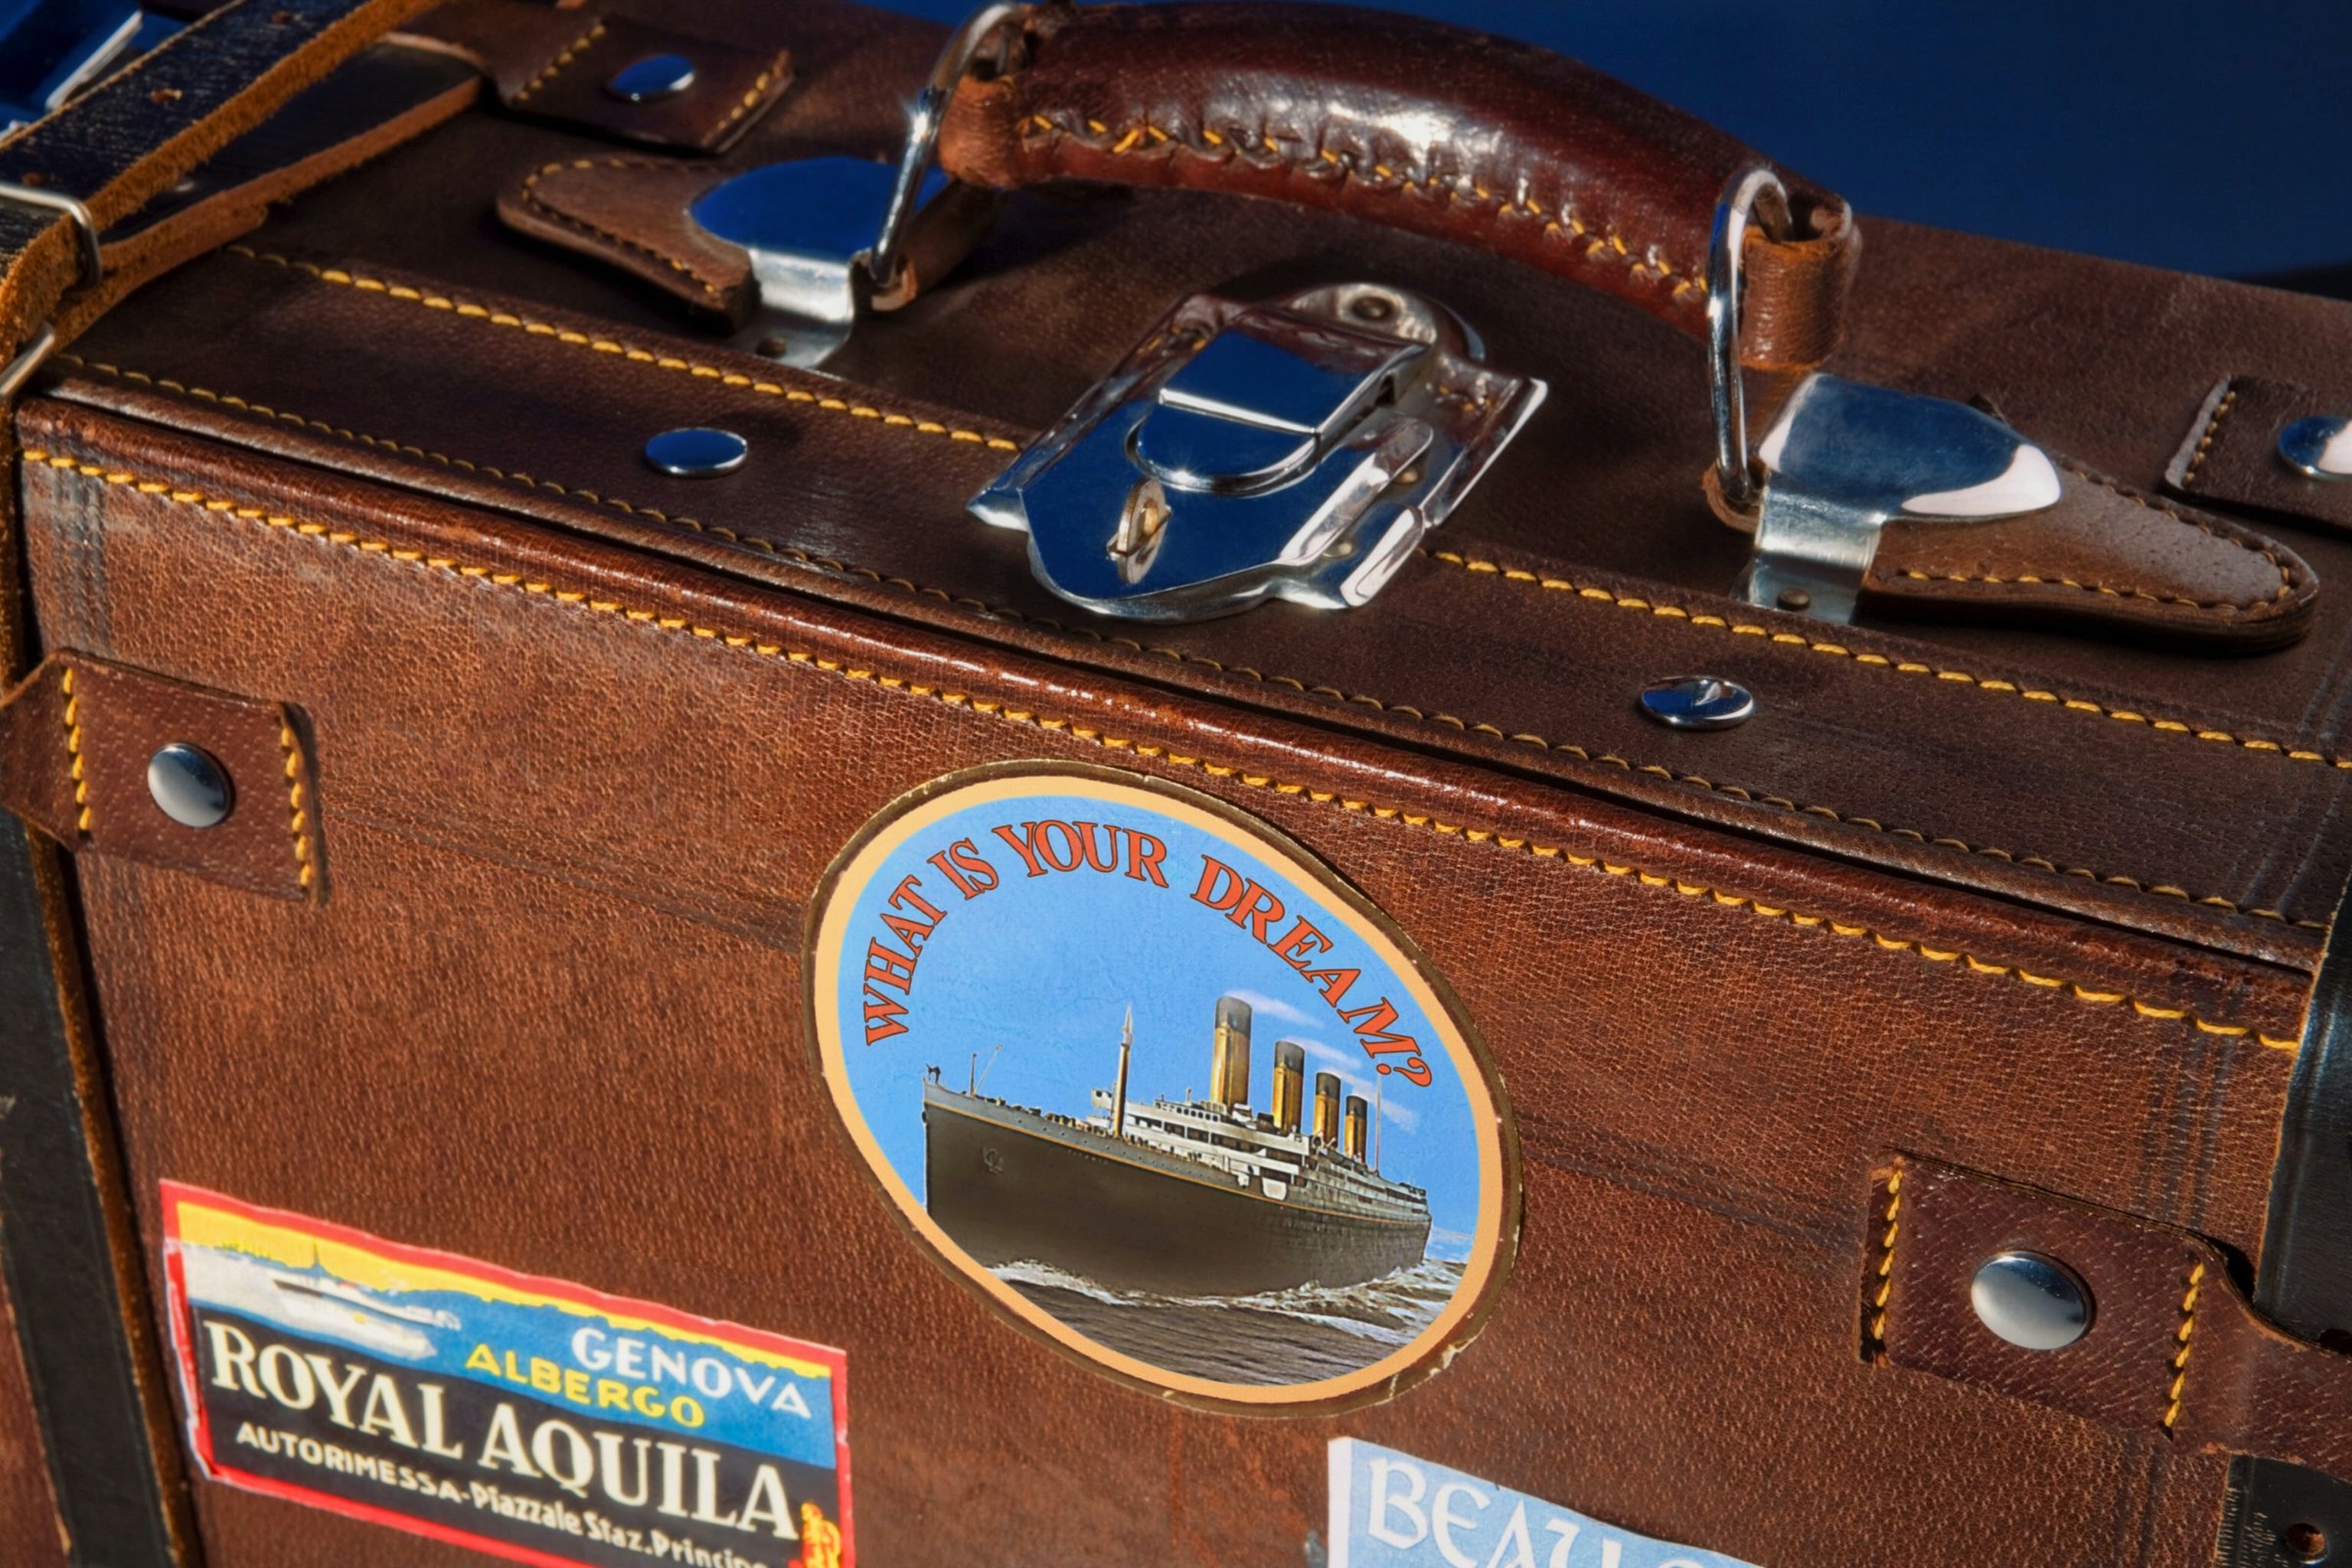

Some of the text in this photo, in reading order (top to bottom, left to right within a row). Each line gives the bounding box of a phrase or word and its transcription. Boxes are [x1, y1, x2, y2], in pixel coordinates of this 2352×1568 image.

[863, 818, 1433, 1088] WHAT IS YOUR DREAM?
[203, 1320, 799, 1540] ROYAL AQUILA
[464, 1343, 705, 1428] ALBERGO
[571, 1327, 812, 1420] GENOVA
